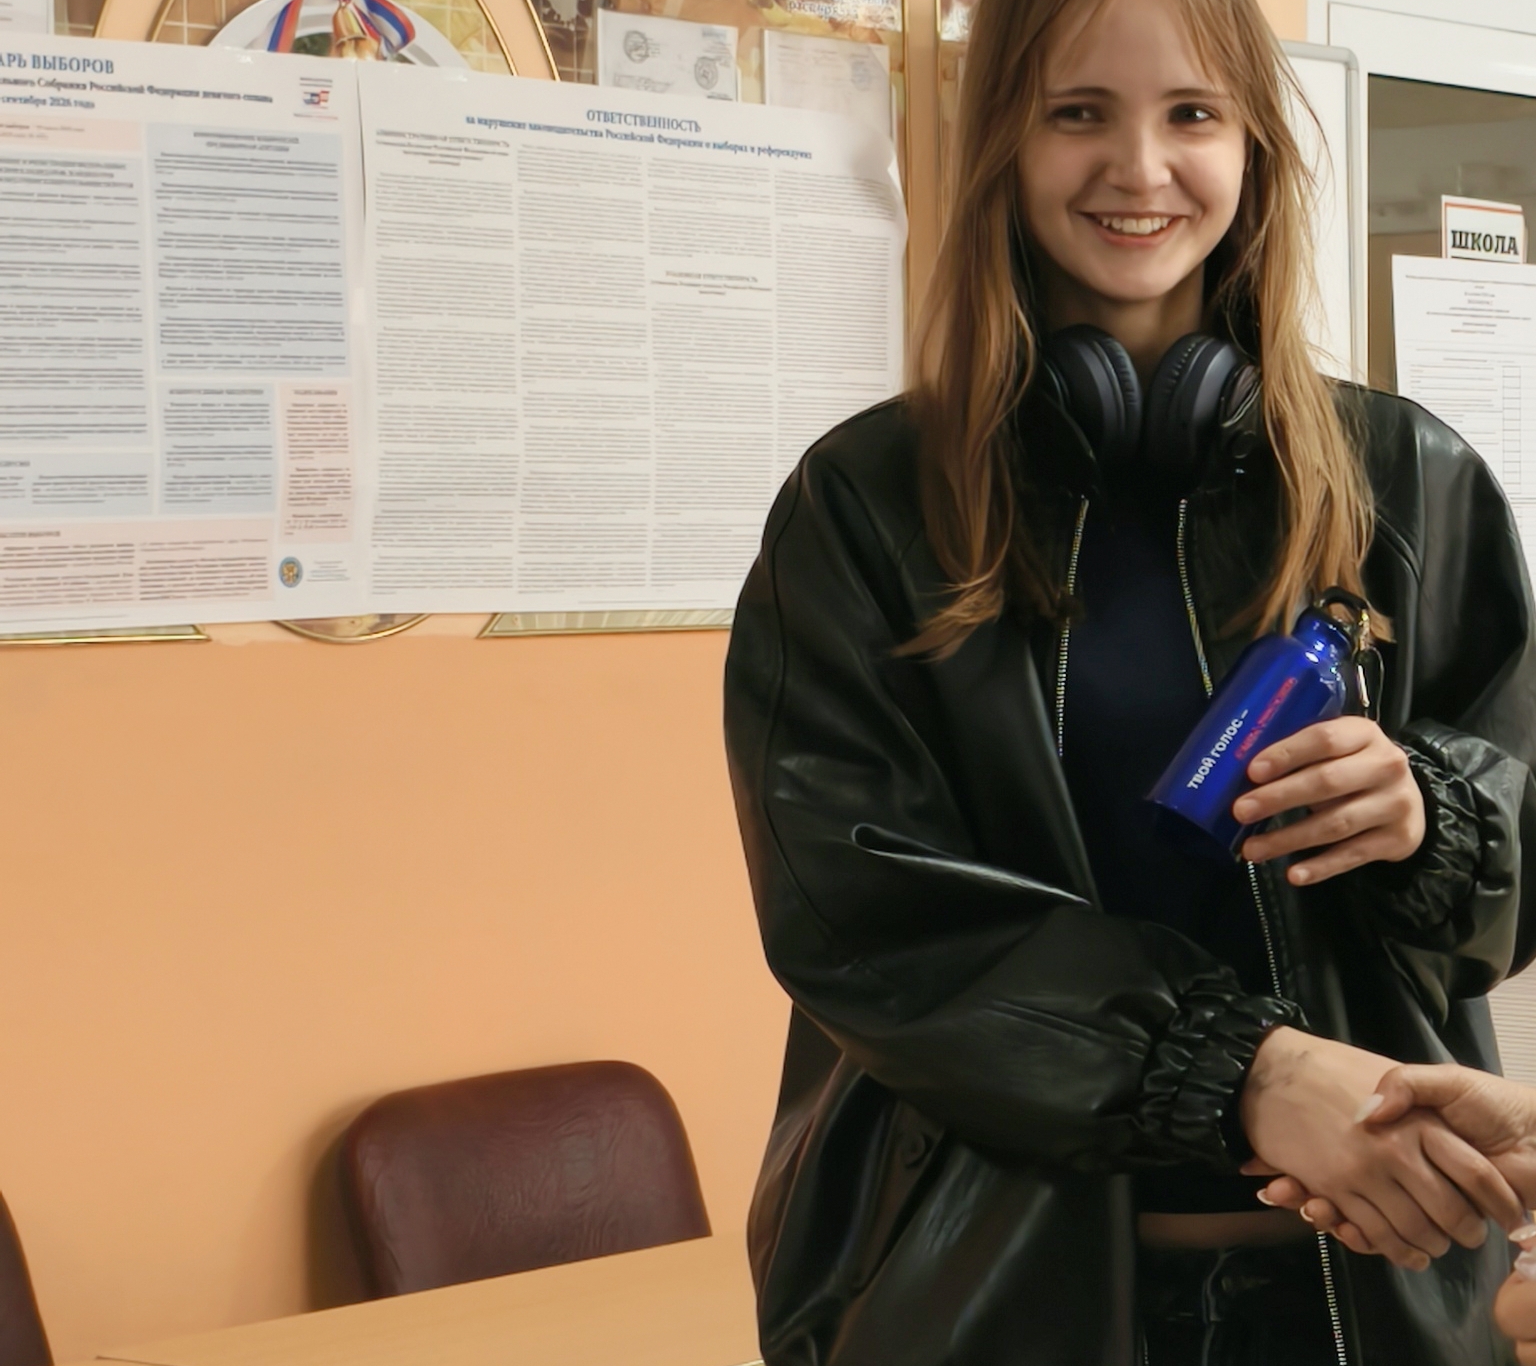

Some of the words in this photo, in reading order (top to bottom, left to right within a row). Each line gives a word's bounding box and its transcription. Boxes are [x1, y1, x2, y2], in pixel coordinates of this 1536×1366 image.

[31, 53, 115, 75] ВЫБОРОВ
[586, 109, 702, 133] ОТВЕТСТВЕННОСТЬ
[1450, 229, 1520, 256] ШКОЛА
